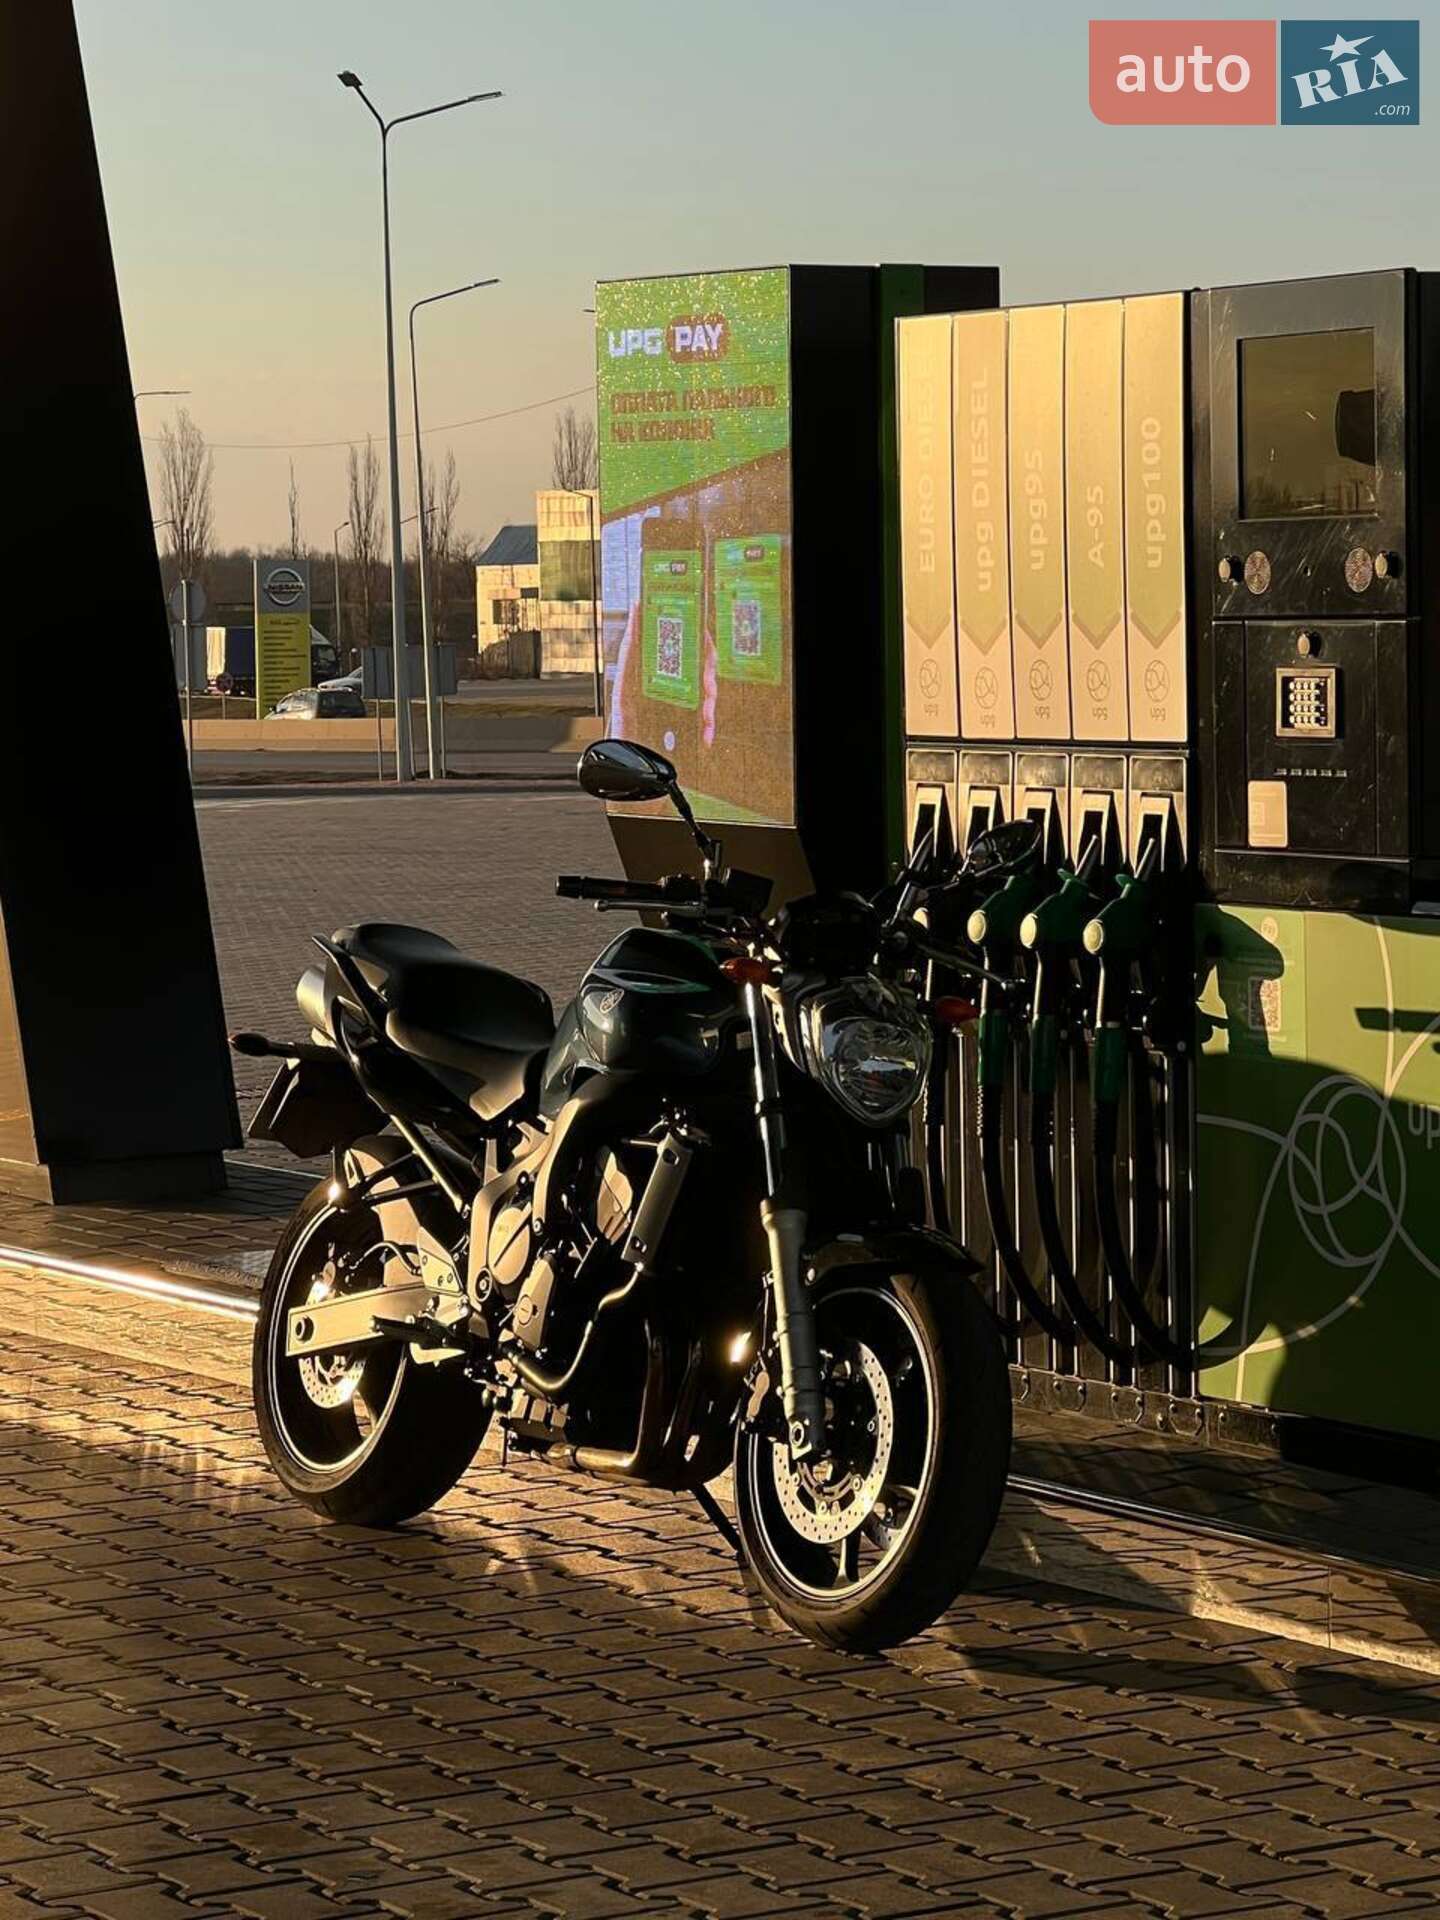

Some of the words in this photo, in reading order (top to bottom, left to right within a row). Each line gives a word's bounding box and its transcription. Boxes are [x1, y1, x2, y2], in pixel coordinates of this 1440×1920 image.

[608, 327, 663, 358] UPG
[674, 323, 724, 353] PAY
[971, 368, 990, 509] DIESEL
[918, 474, 936, 574] EURO
[976, 521, 995, 592] upg
